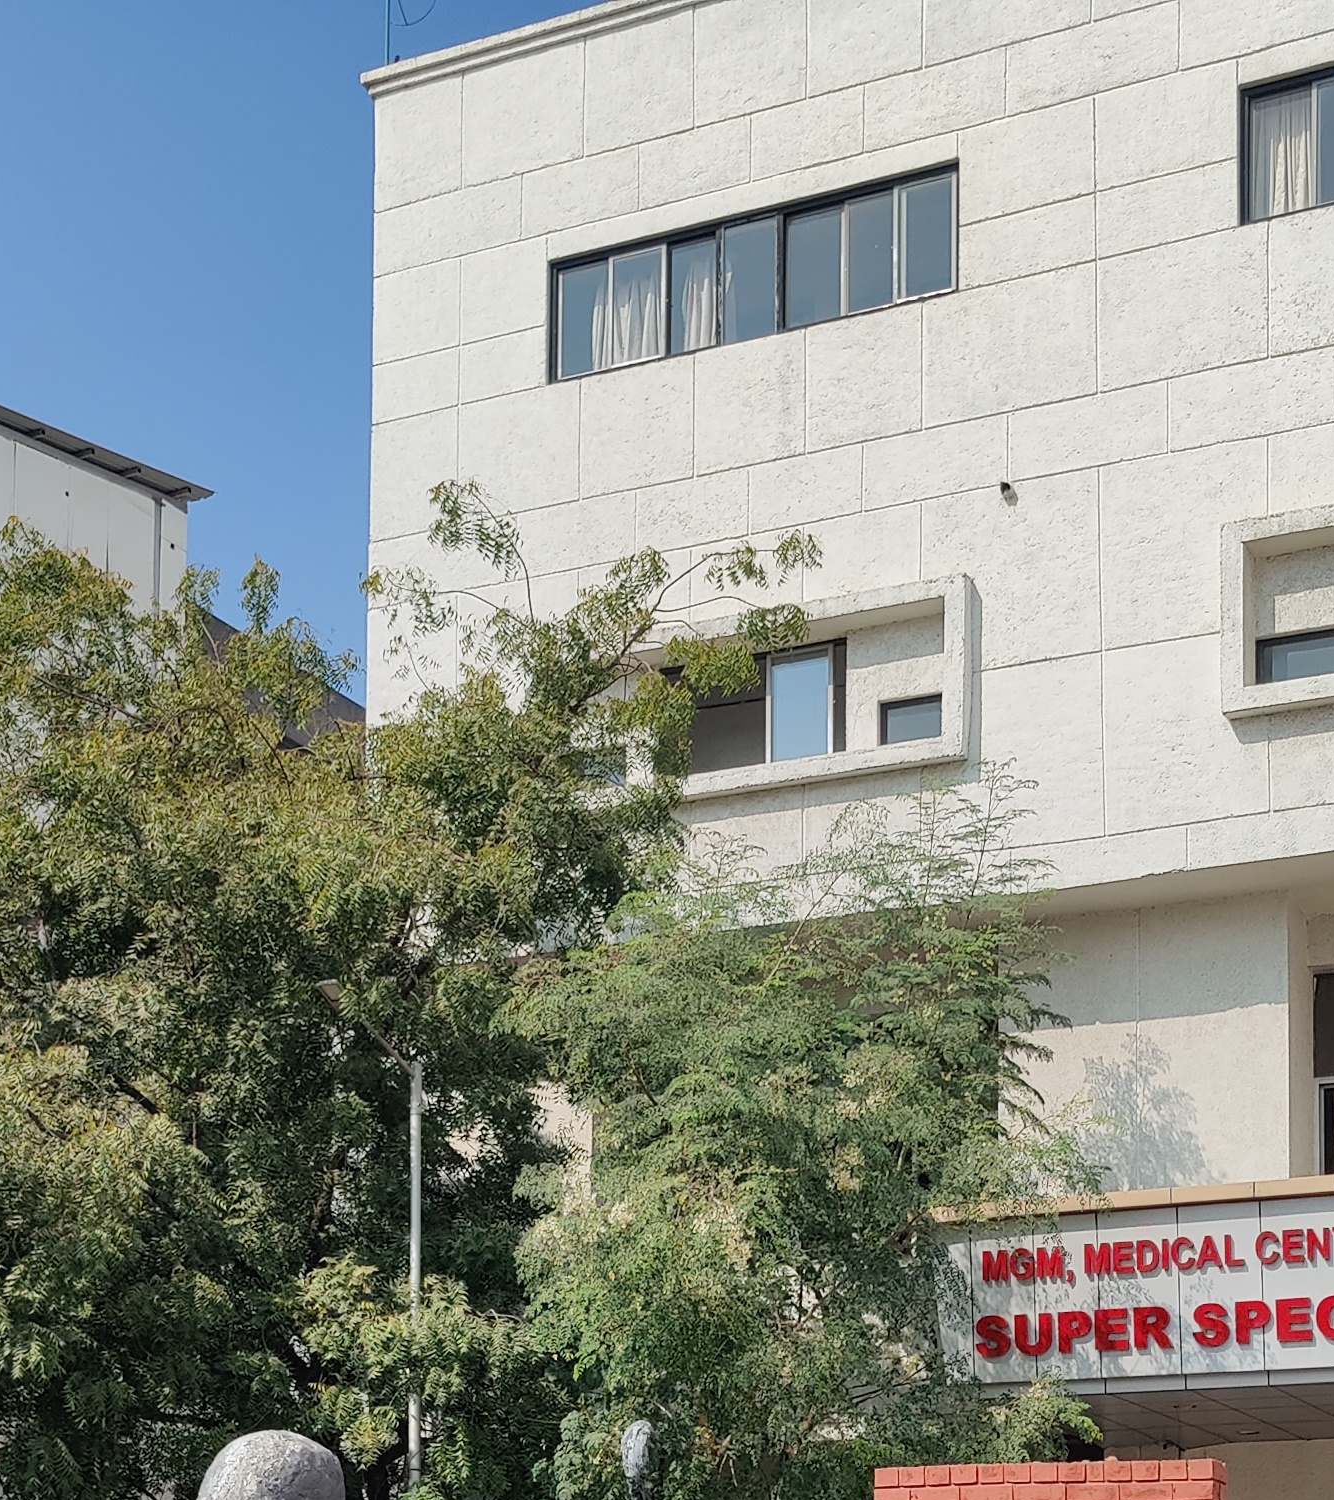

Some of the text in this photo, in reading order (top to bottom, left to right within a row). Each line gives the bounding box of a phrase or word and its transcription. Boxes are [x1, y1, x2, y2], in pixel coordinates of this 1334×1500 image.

[981, 1245, 1076, 1282] MGM,
[1084, 1234, 1245, 1275] MEDICAL
[975, 1305, 1174, 1358] SUPER
